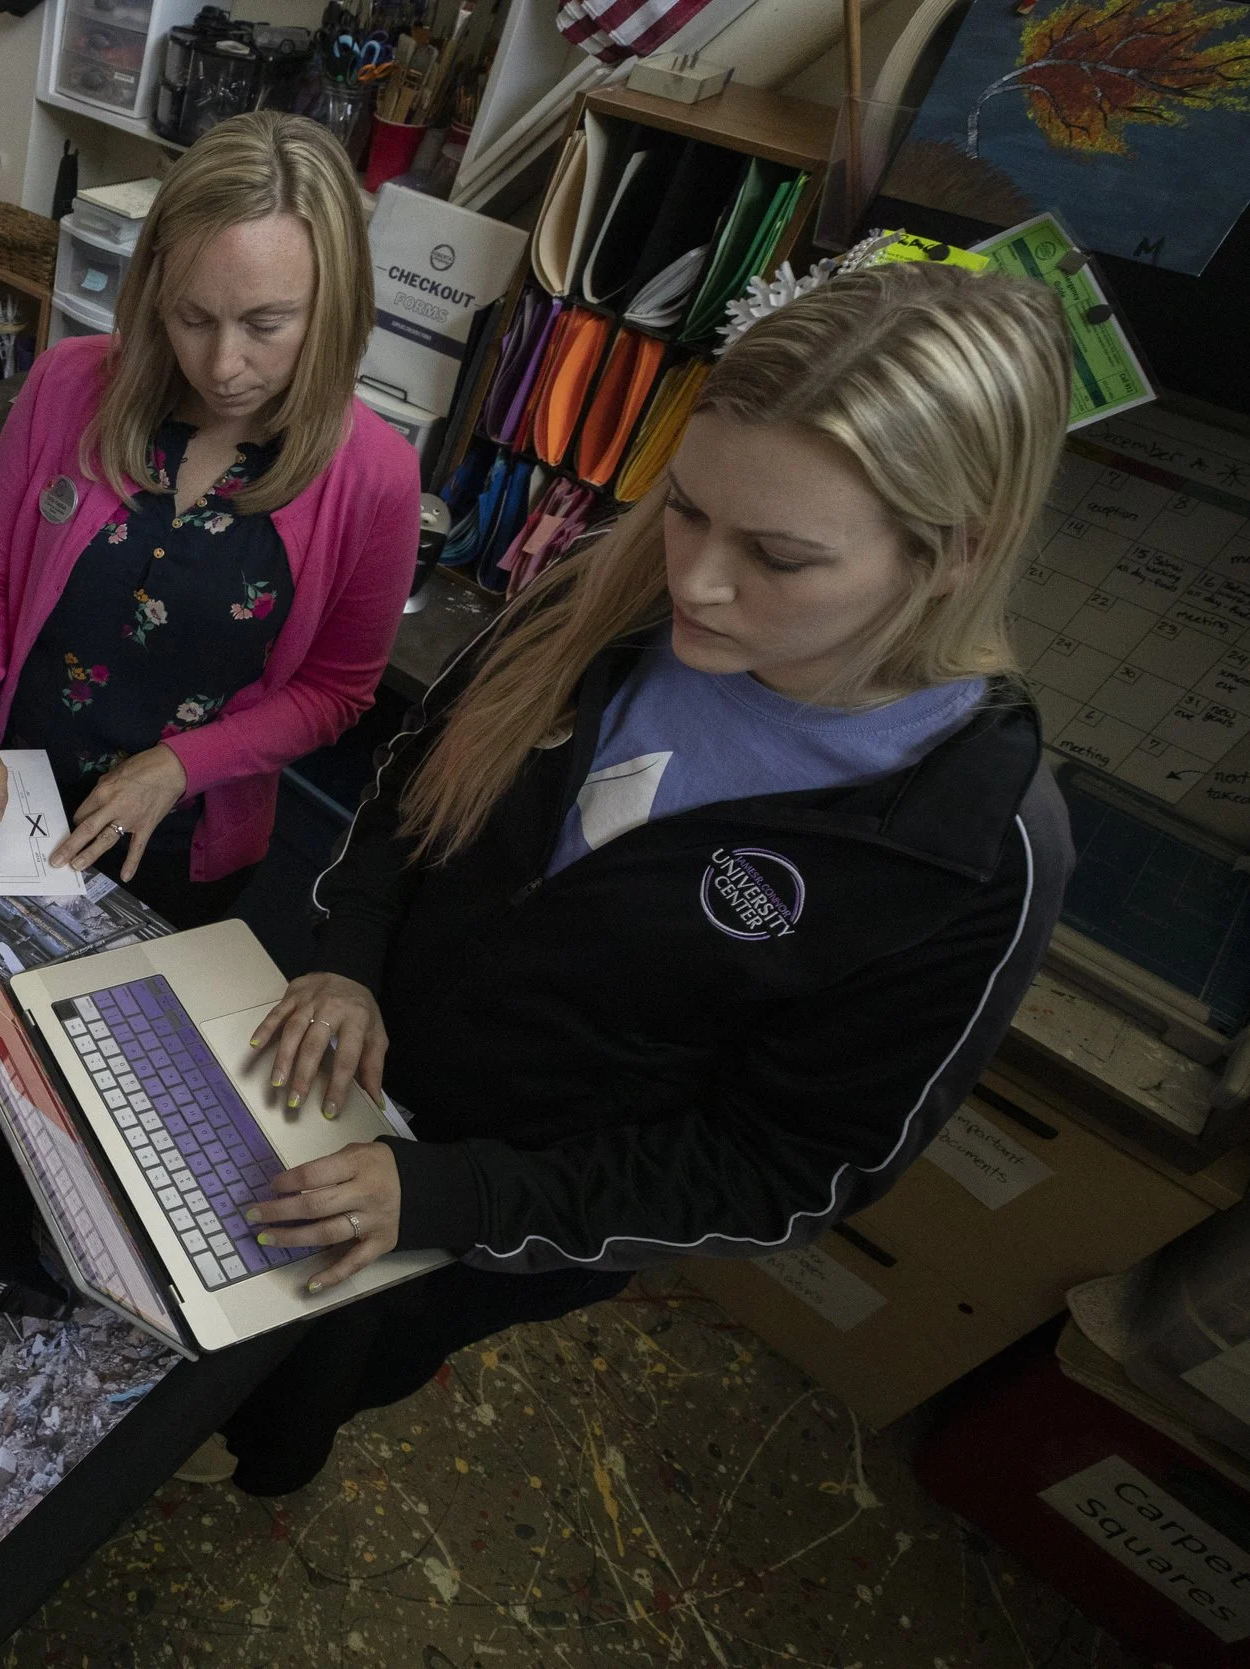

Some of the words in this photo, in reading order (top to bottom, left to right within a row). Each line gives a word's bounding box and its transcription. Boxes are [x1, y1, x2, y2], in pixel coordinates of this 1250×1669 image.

[388, 265, 475, 308] CHECKOUT
[393, 292, 450, 324] FORMS
[1173, 497, 1190, 510] 8
[1068, 521, 1084, 535] 14
[1132, 547, 1150, 560] 15
[1197, 573, 1215, 588] 16
[1091, 593, 1110, 607] 22
[1157, 620, 1178, 636] 23
[1059, 739, 1111, 768] meeting
[711, 848, 795, 938] UNIVERSITY
[735, 856, 759, 879] JAMES
[761, 883, 792, 918] CONNOR
[714, 875, 763, 930] CENTER
[955, 1113, 1026, 1166] mportant
[1114, 1481, 1250, 1590] Carpet
